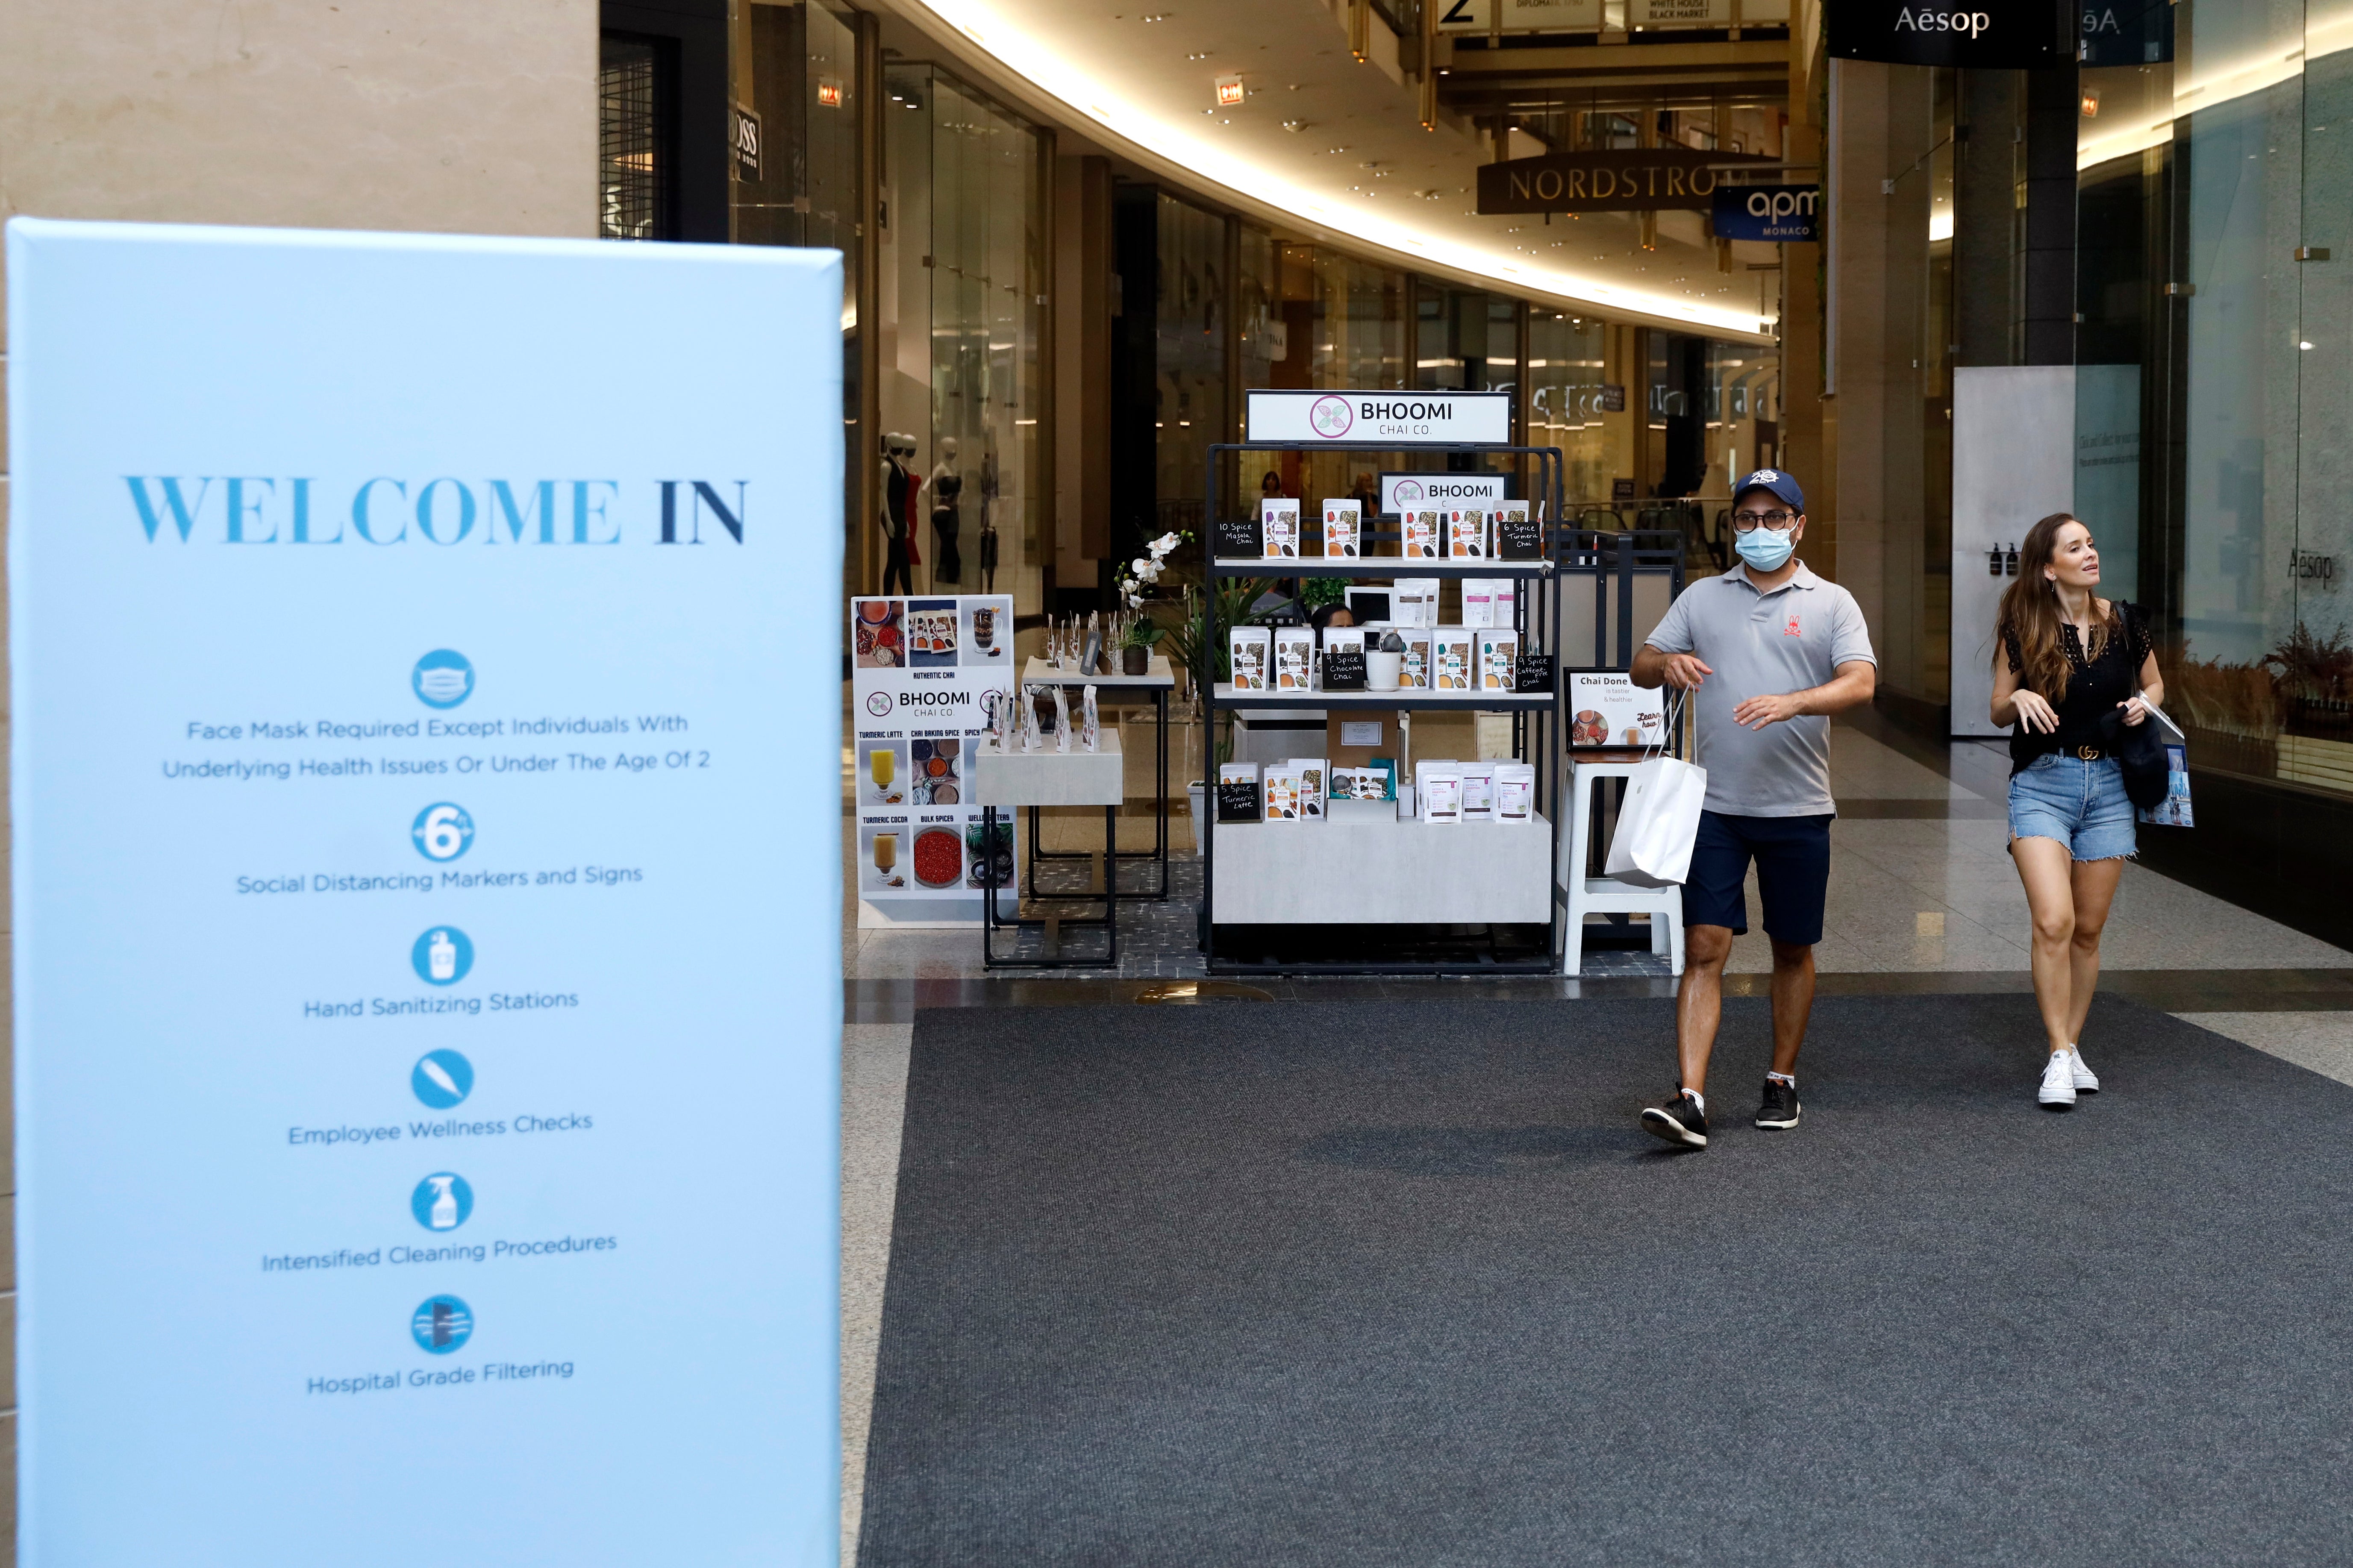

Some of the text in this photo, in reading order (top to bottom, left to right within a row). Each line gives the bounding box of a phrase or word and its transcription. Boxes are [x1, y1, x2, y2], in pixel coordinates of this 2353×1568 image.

[1649, 9, 1709, 20] BLACK MARKET
[1220, 83, 1238, 100] EXIT
[1762, 226, 1810, 236] MONACO
[1361, 402, 1452, 420] BHOOMI
[1379, 425, 1432, 435] CHAI CO.
[1429, 485, 1492, 497] BHOOMI
[121, 476, 750, 546] WELCOME IN
[1231, 523, 1252, 533] Spice
[1514, 523, 1535, 533] Spice
[1327, 654, 1359, 665] 9 Spice
[1519, 657, 1547, 667] 9 Spice
[1522, 678, 1539, 687] Chai
[900, 692, 970, 705] BHOOMI
[1637, 712, 1662, 721] Learn
[187, 715, 688, 741] Face Mask Required Except Individuals With
[163, 750, 710, 781] Underlying Health Issues Or Under The Age Of 2
[1230, 785, 1252, 794] Spice
[1222, 793, 1255, 803] Turmeric
[424, 806, 462, 858] 6
[236, 866, 643, 894] Social Distancing Markers and Signs
[304, 992, 579, 1018] Hand Sanitizing Stations
[287, 1113, 594, 1146] Employee Wellness Checks
[262, 1235, 618, 1272] Intensified Cleaning Procedures
[306, 1360, 575, 1395] Hospital Grade Filtering
